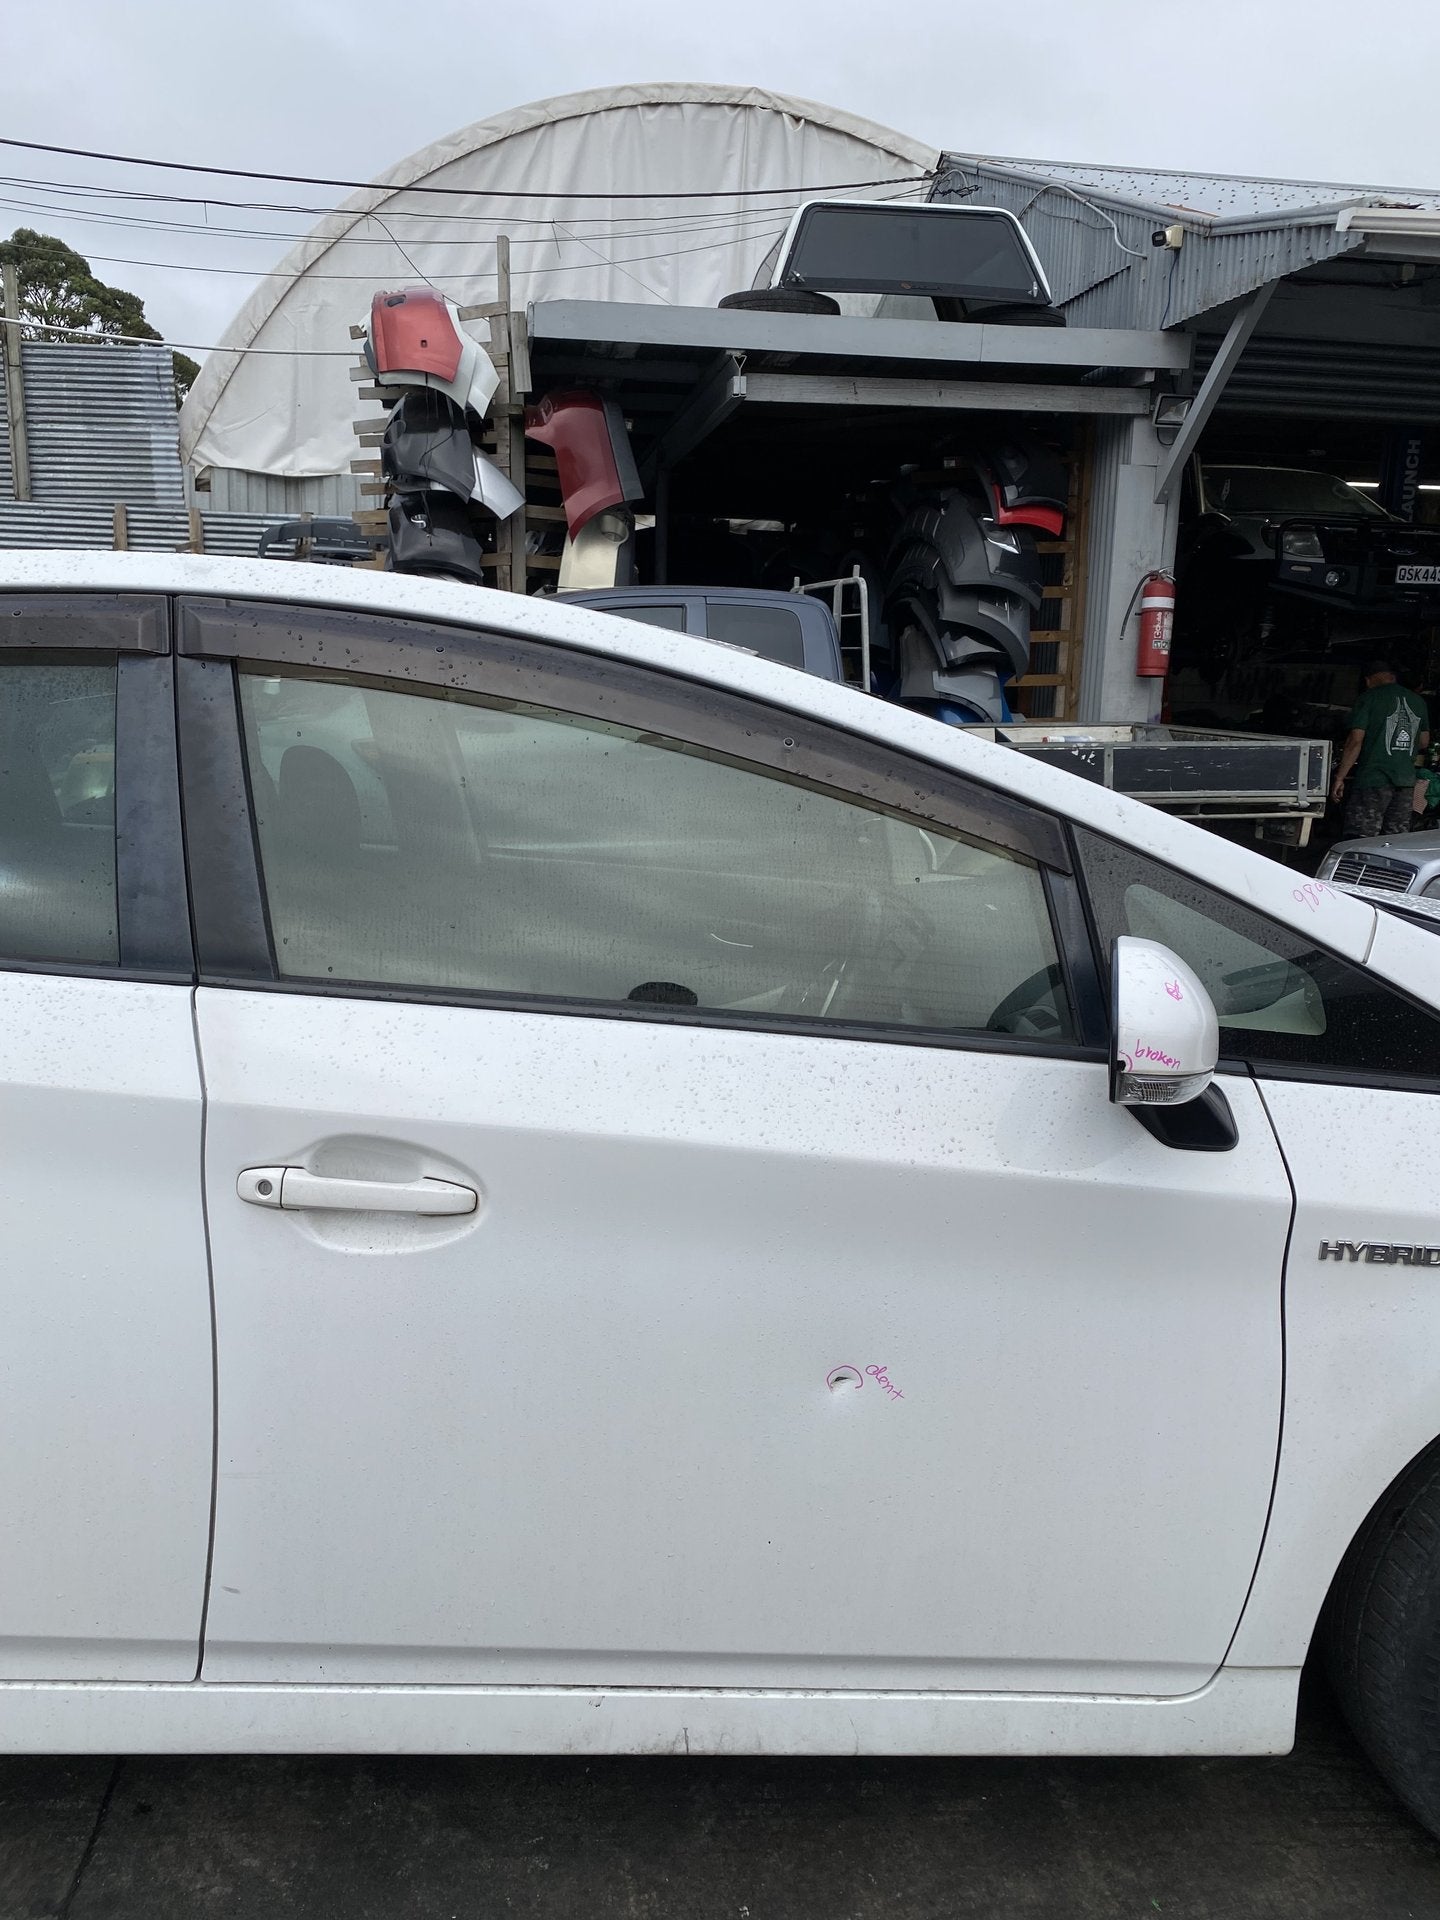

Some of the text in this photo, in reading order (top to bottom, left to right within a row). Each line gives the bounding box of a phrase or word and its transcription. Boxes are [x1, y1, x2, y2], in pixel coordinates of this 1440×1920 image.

[1401, 440, 1421, 522] LAUNCH
[1135, 1039, 1181, 1069] broken
[1318, 1239, 1440, 1266] HYBRID
[865, 1365, 904, 1400] dent
